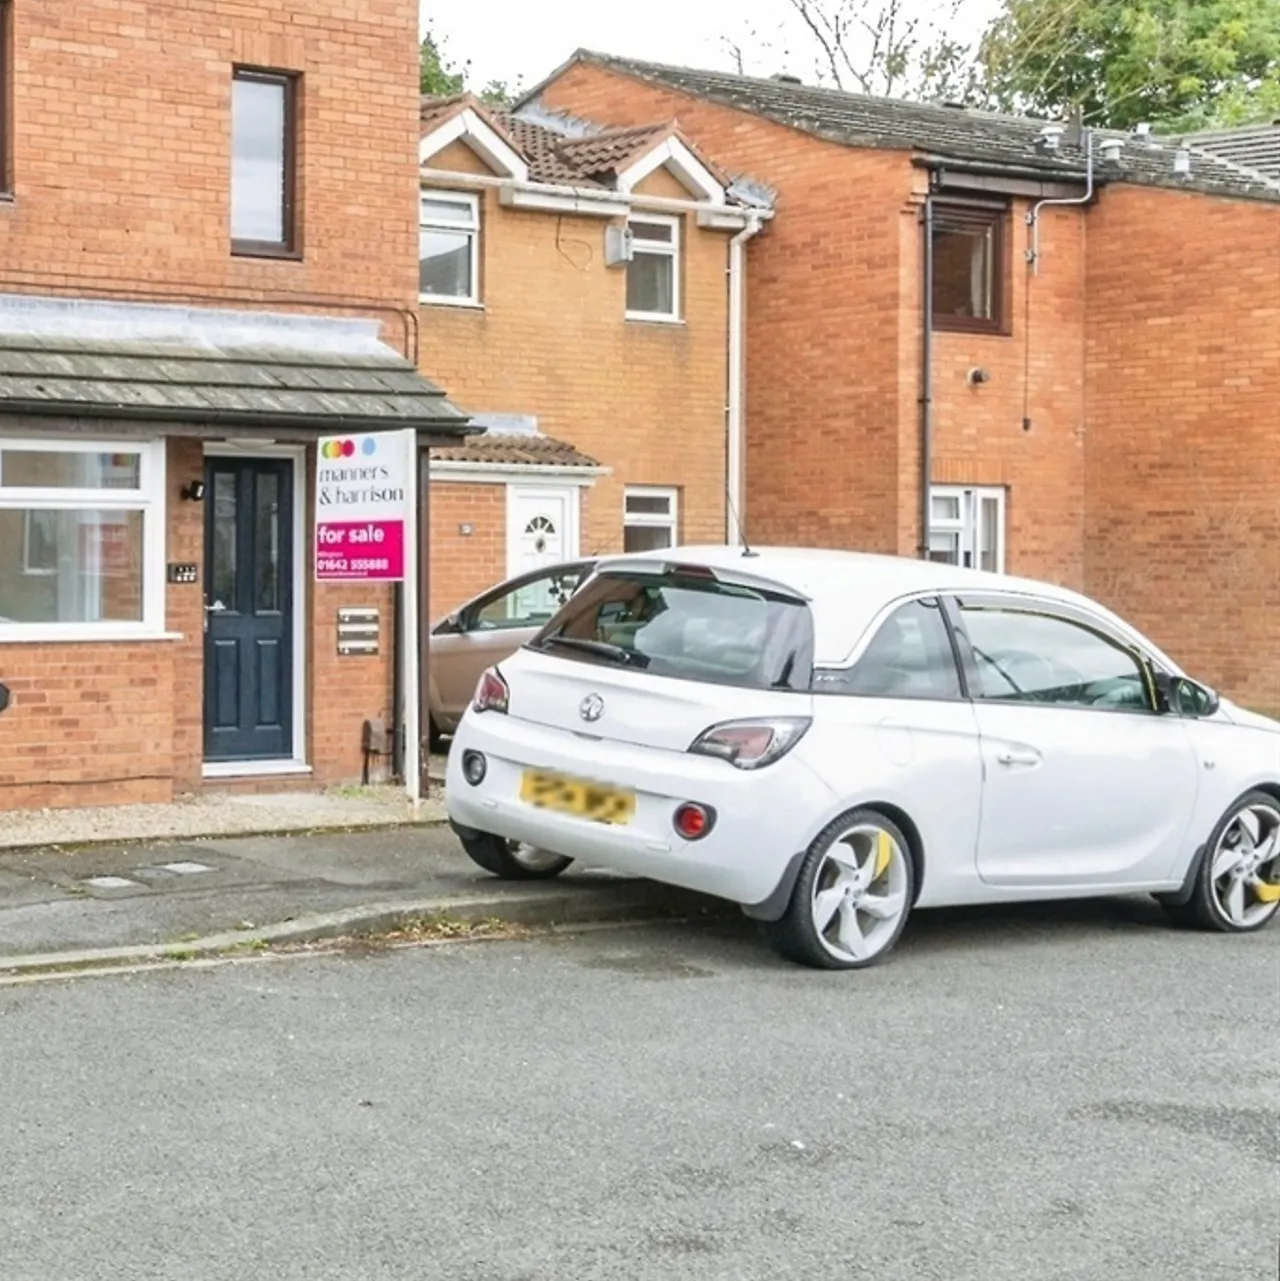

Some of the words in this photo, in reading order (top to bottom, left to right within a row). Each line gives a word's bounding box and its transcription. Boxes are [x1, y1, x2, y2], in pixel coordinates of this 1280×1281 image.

[319, 467, 388, 482] manners
[319, 487, 332, 505] &
[336, 486, 404, 504] harrison
[318, 525, 345, 544] for
[348, 524, 385, 543] sale
